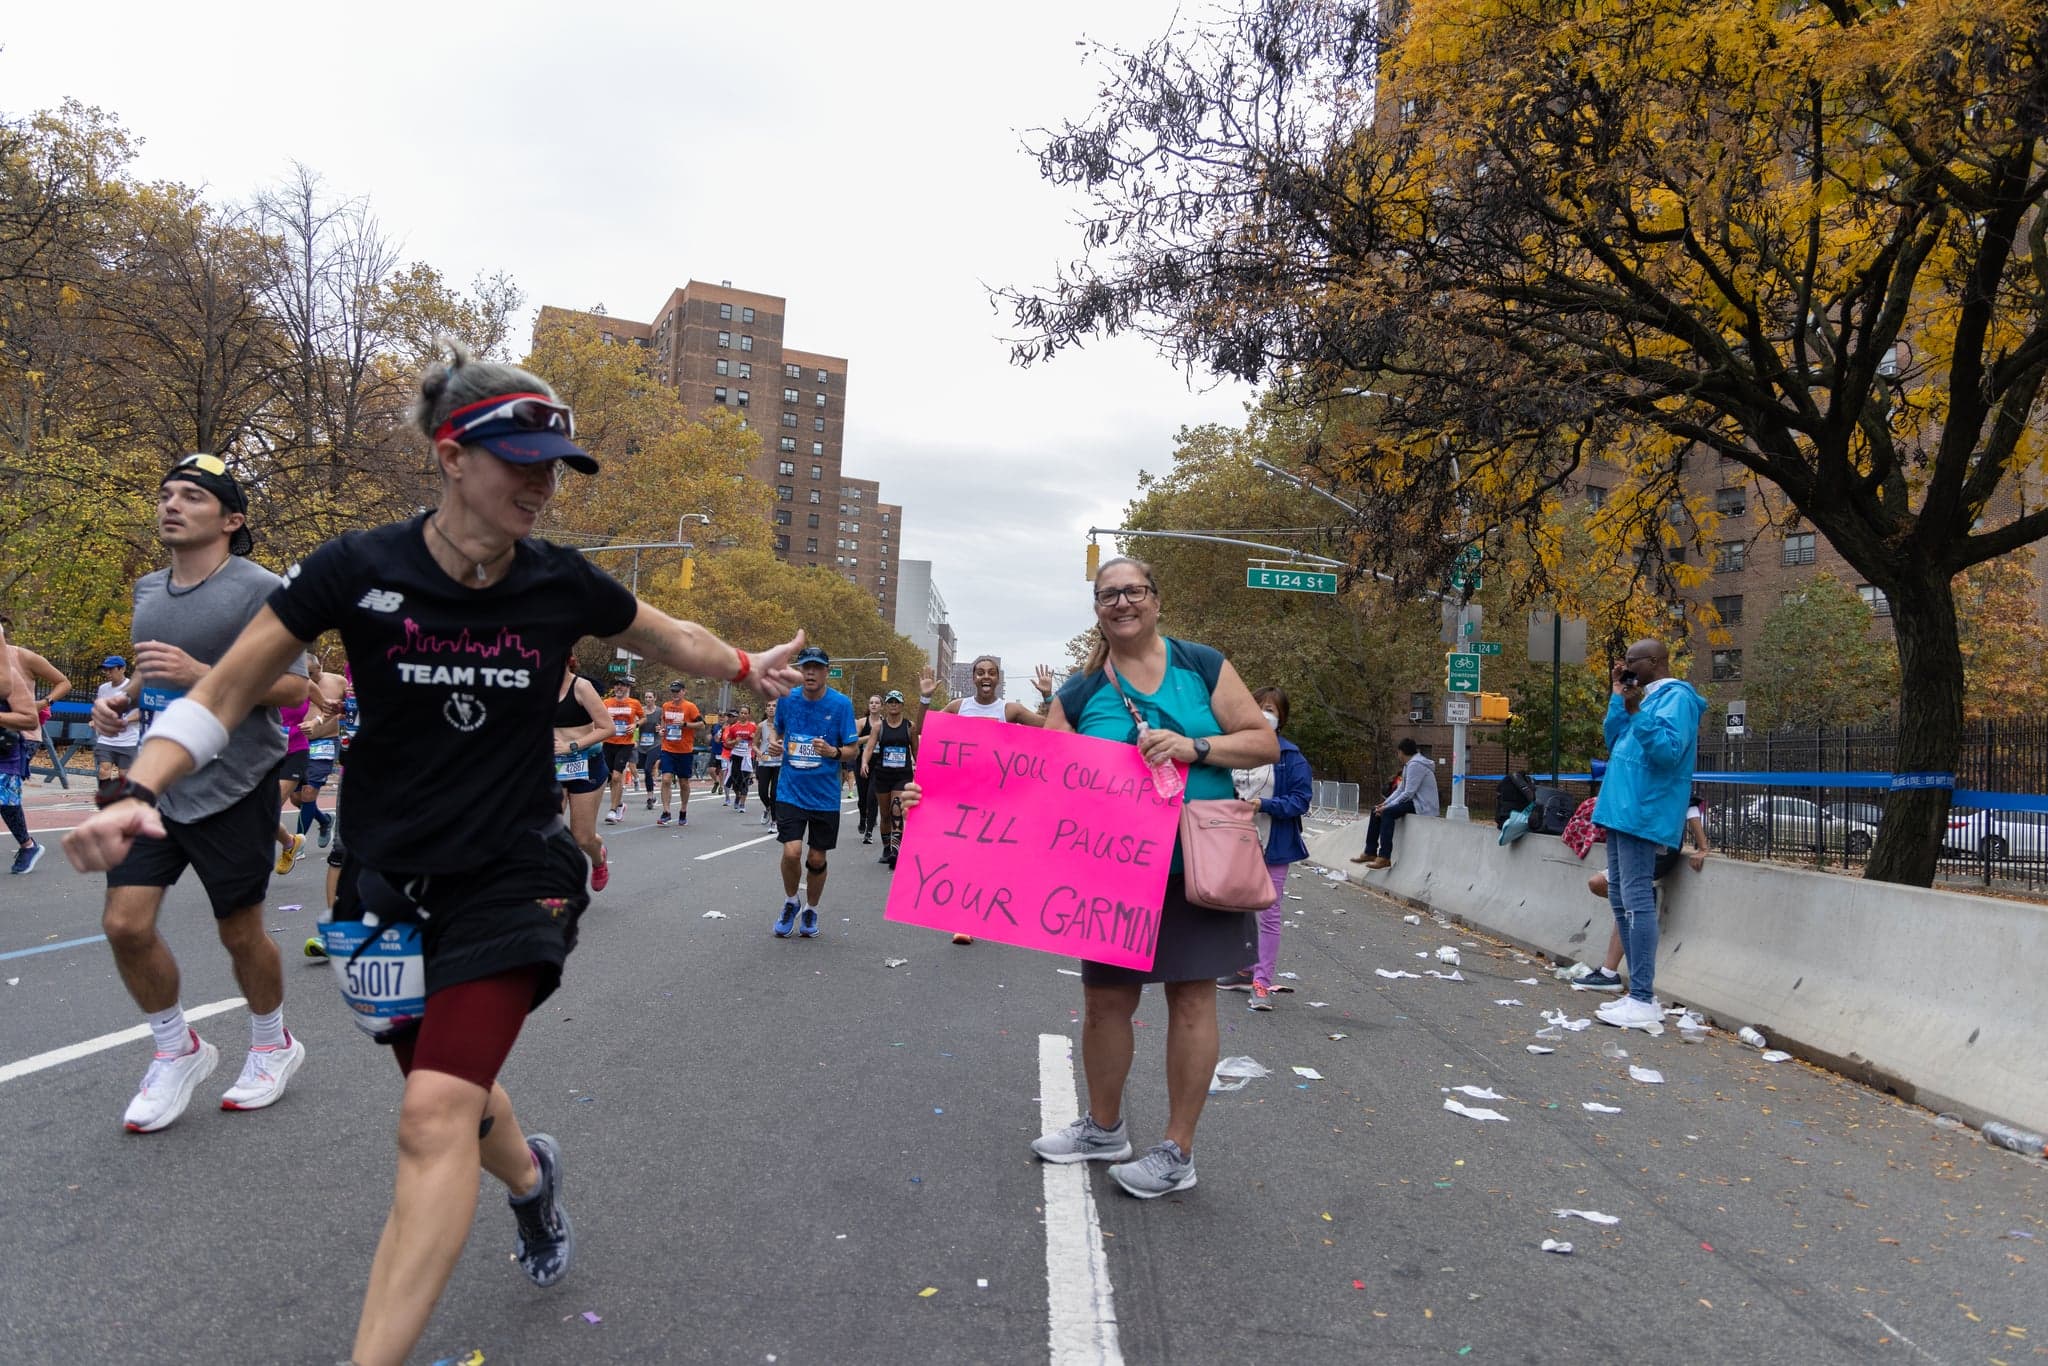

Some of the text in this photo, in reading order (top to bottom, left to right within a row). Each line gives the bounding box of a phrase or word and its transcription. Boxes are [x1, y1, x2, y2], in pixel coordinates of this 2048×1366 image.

[1261, 573, 1324, 589] E 124 St
[1478, 644, 1490, 653] 124
[398, 662, 530, 689] TEAM TCS
[932, 740, 979, 769] IF
[993, 748, 1048, 789] YOU
[943, 803, 1158, 867] I'LL PAUSE
[914, 854, 1162, 958] YOUR GARMIN
[379, 942, 402, 951] TATA
[346, 962, 404, 996] 51017
